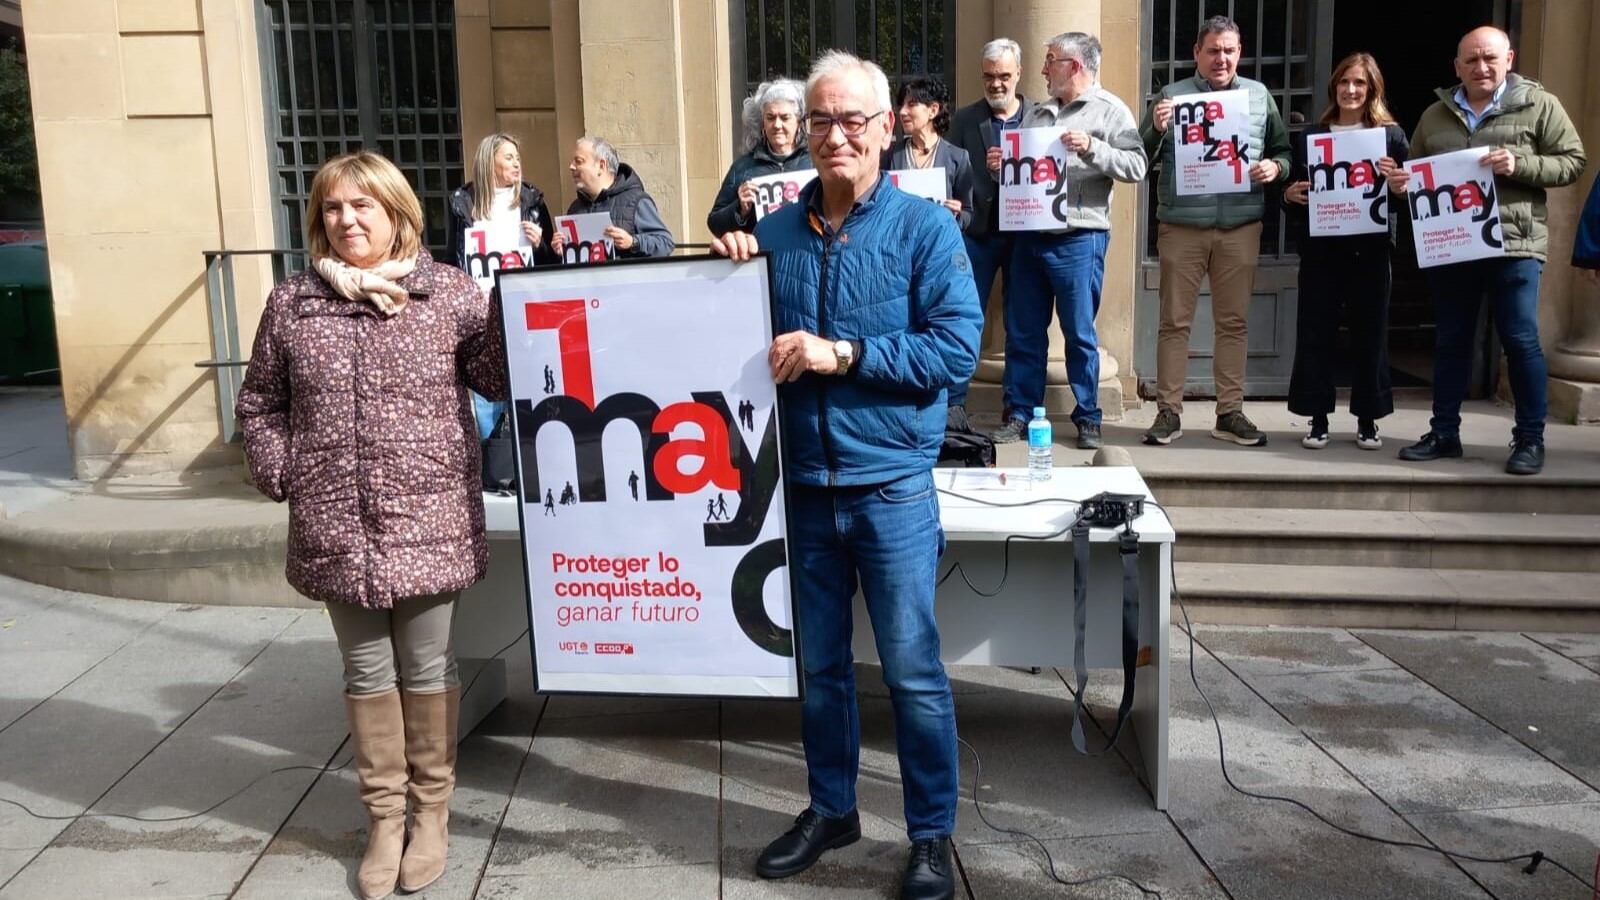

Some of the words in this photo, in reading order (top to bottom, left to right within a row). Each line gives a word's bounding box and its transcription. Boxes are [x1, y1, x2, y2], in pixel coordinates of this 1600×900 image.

[1409, 180, 1496, 222] may
[514, 390, 782, 547] may
[552, 553, 650, 578] Proteger
[659, 551, 679, 572] lo
[554, 576, 702, 602] conquistado,
[557, 605, 622, 627] ganar
[632, 601, 700, 622] futuro
[559, 641, 578, 651] UGT
